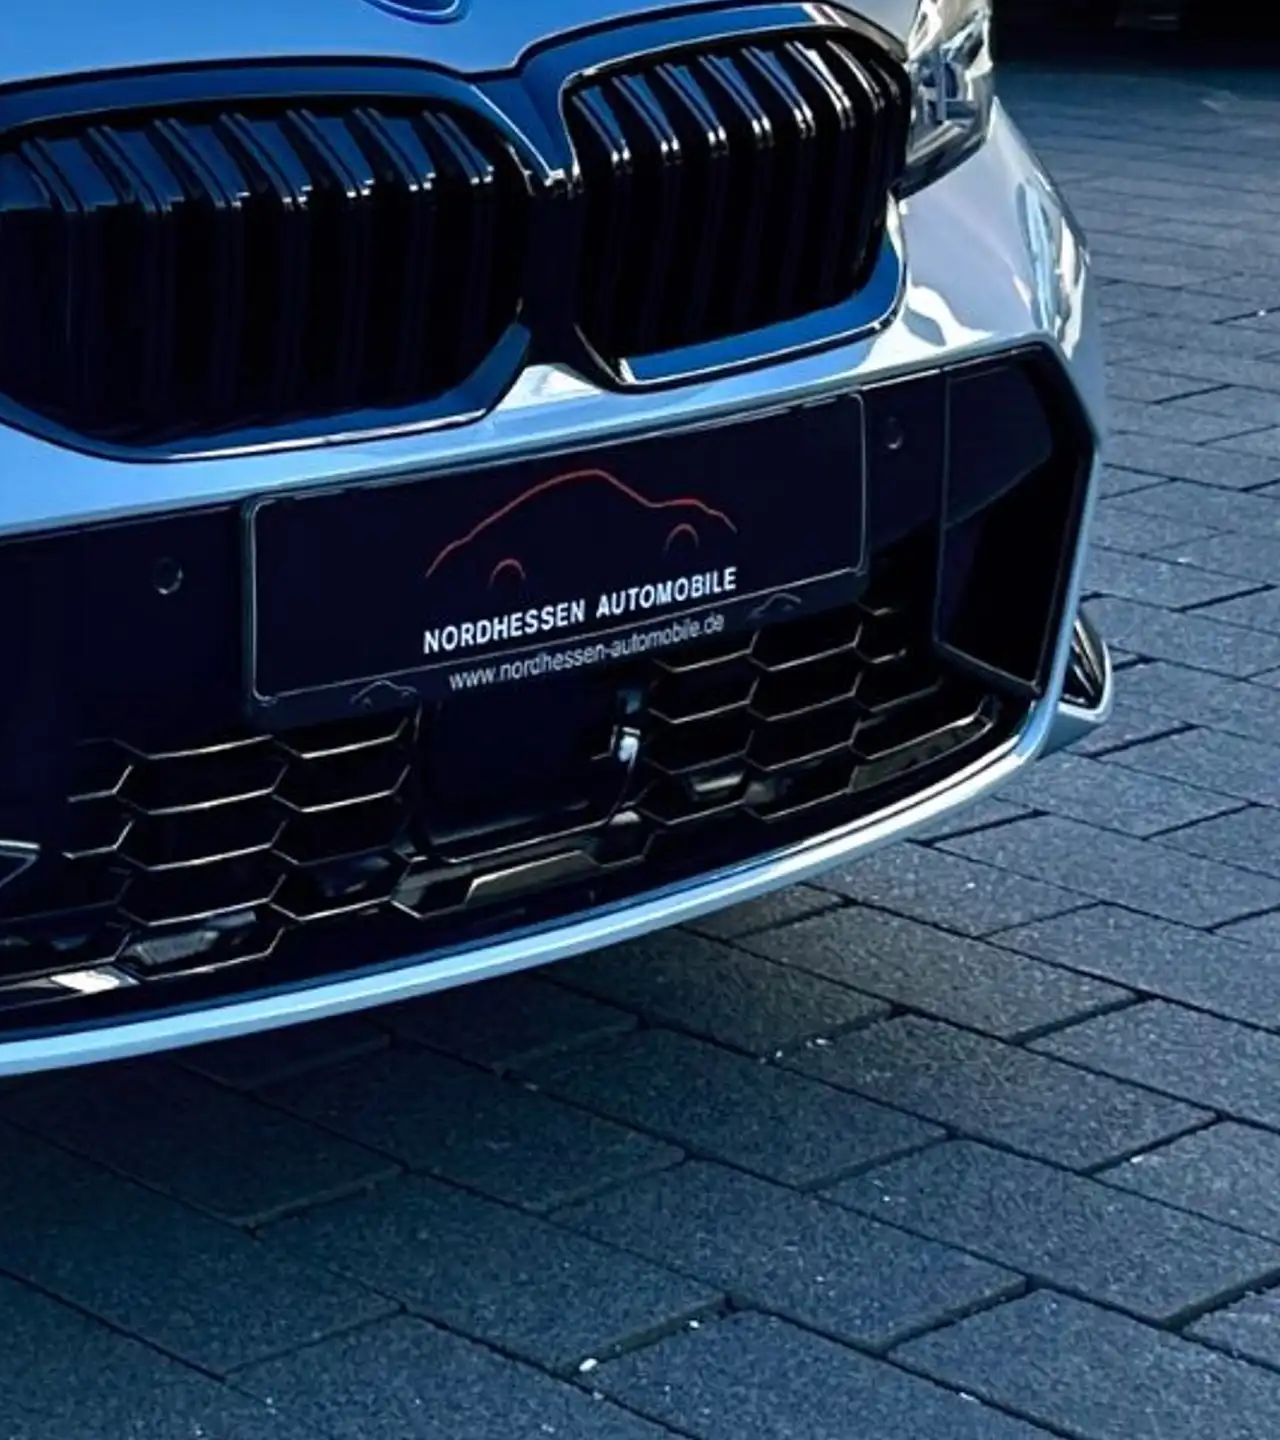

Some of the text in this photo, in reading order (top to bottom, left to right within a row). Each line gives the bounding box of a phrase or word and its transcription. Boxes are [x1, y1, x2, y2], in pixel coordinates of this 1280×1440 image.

[423, 566, 737, 654] NORDHESSEN AUTOMOBILE
[449, 612, 725, 691] www.nordhessen-automobile.de
